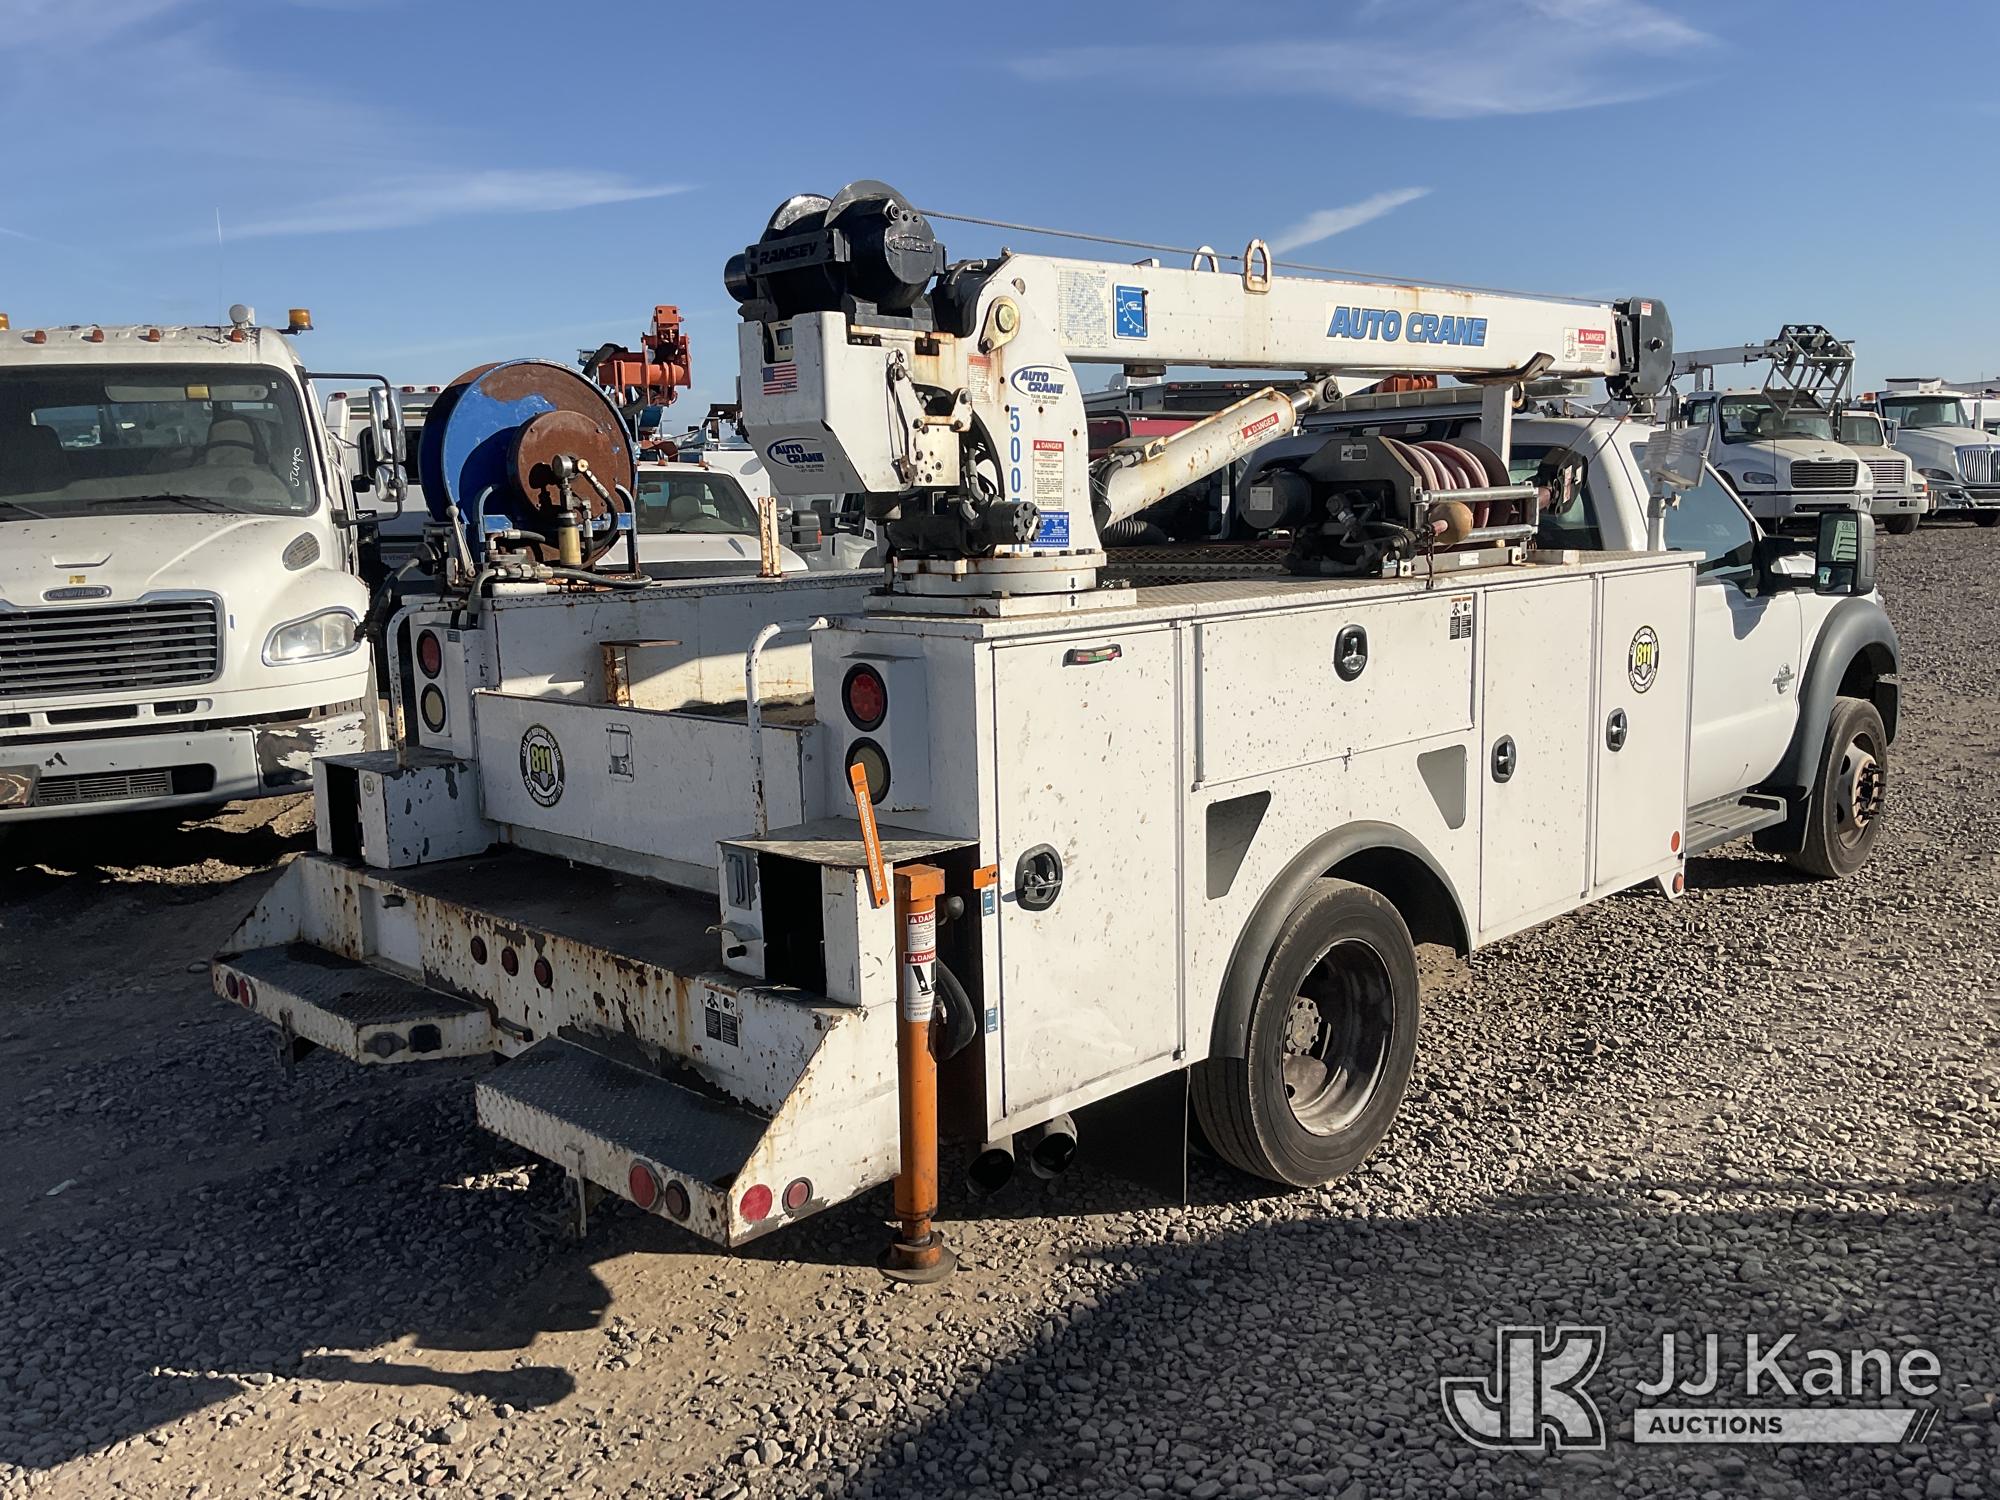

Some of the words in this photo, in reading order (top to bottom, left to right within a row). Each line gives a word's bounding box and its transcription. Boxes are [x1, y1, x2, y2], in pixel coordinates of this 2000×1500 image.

[760, 241, 817, 265] RAMSEY
[1327, 306, 1402, 342] AUTO
[1405, 312, 1488, 347] CRANE
[1585, 333, 1605, 341] DANGER
[1020, 370, 1049, 382] AUTO
[1027, 382, 1063, 394] CRANE
[1252, 416, 1276, 433] DANGER
[776, 444, 803, 454] AUTO
[1041, 442, 1063, 450] DANGER
[786, 453, 824, 464] CRANE
[1636, 642, 1652, 667] 811
[530, 743, 552, 775] 811
[918, 911, 935, 923] DANG
[917, 953, 935, 962] DANG
